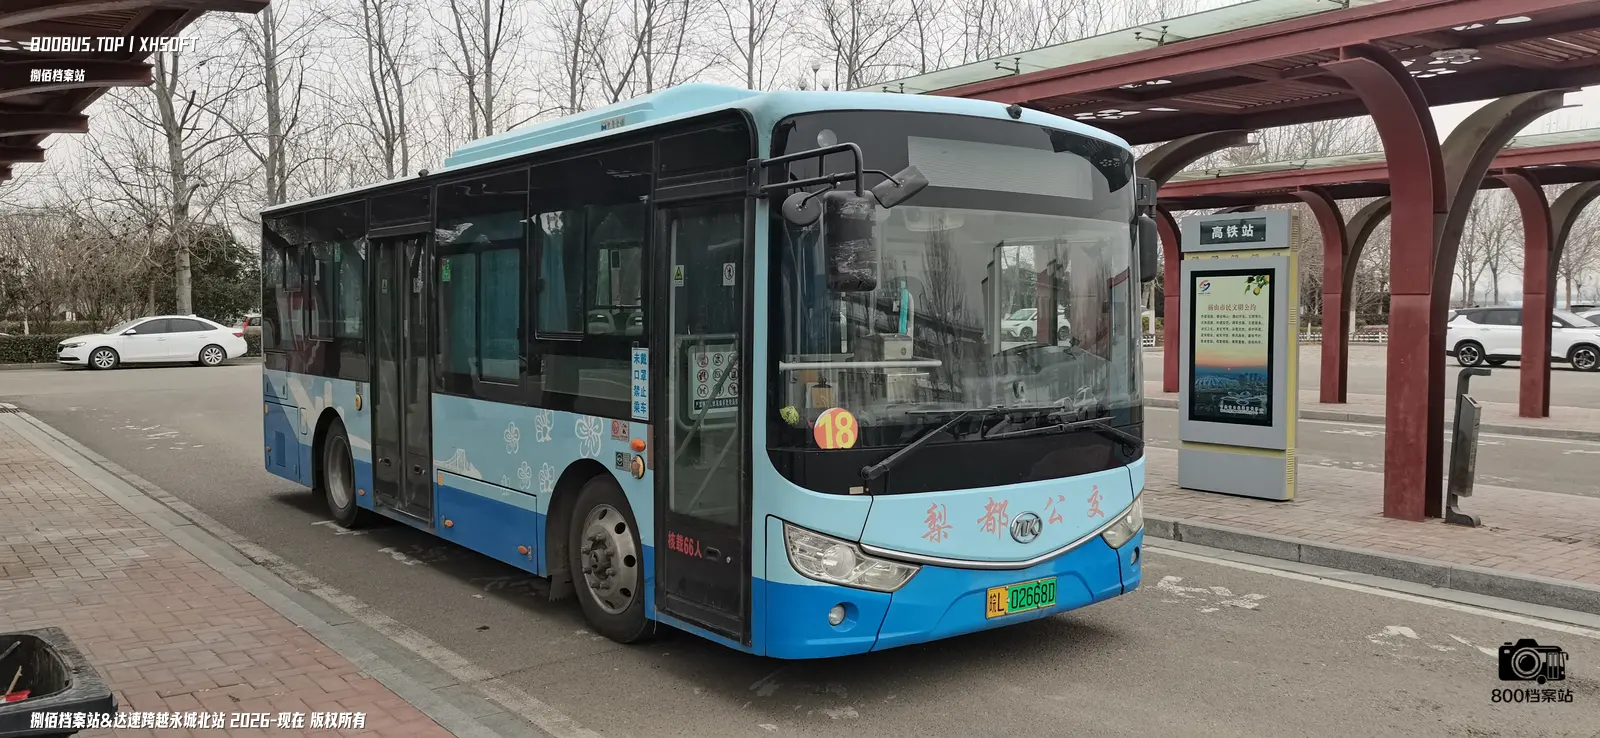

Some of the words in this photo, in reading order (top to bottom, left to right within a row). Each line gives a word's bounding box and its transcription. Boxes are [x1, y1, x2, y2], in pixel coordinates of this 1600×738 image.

[1211, 223, 1254, 239] 高铁站
[817, 411, 856, 449] 18
[667, 530, 703, 558] 核载66人
